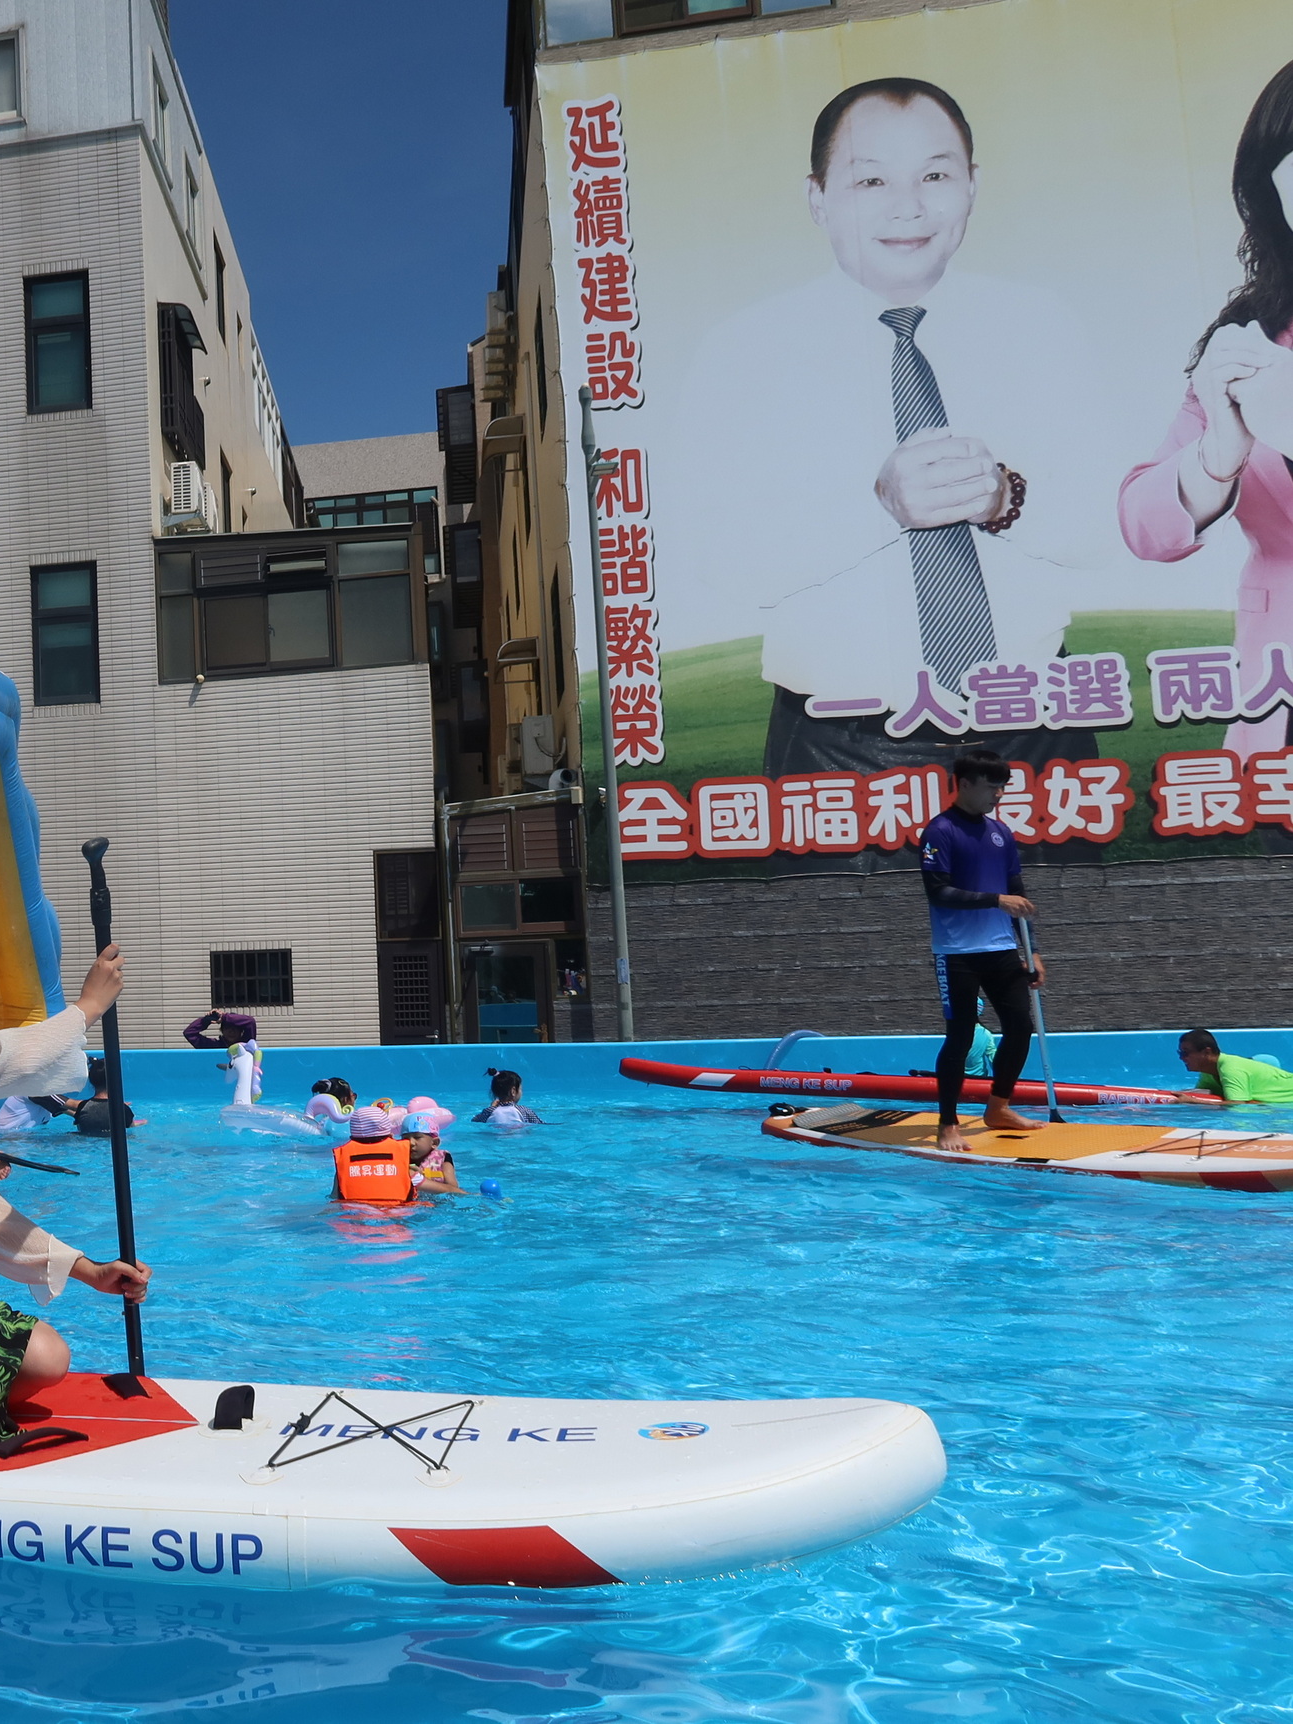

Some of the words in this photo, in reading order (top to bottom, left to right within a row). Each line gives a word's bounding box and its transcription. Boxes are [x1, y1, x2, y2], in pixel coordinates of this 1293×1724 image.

[566, 99, 639, 401] 延續建設
[595, 447, 660, 758] 和諧繁榮
[811, 657, 1126, 731] 一人當選
[1154, 647, 1293, 716] 兩人
[759, 1076, 800, 1089] MENG
[802, 1078, 822, 1090] KE
[823, 1078, 853, 1092] SUP
[278, 1422, 481, 1443] MENG
[507, 1426, 599, 1443] KE
[64, 1523, 134, 1569] KE
[150, 1528, 264, 1576] SUP
